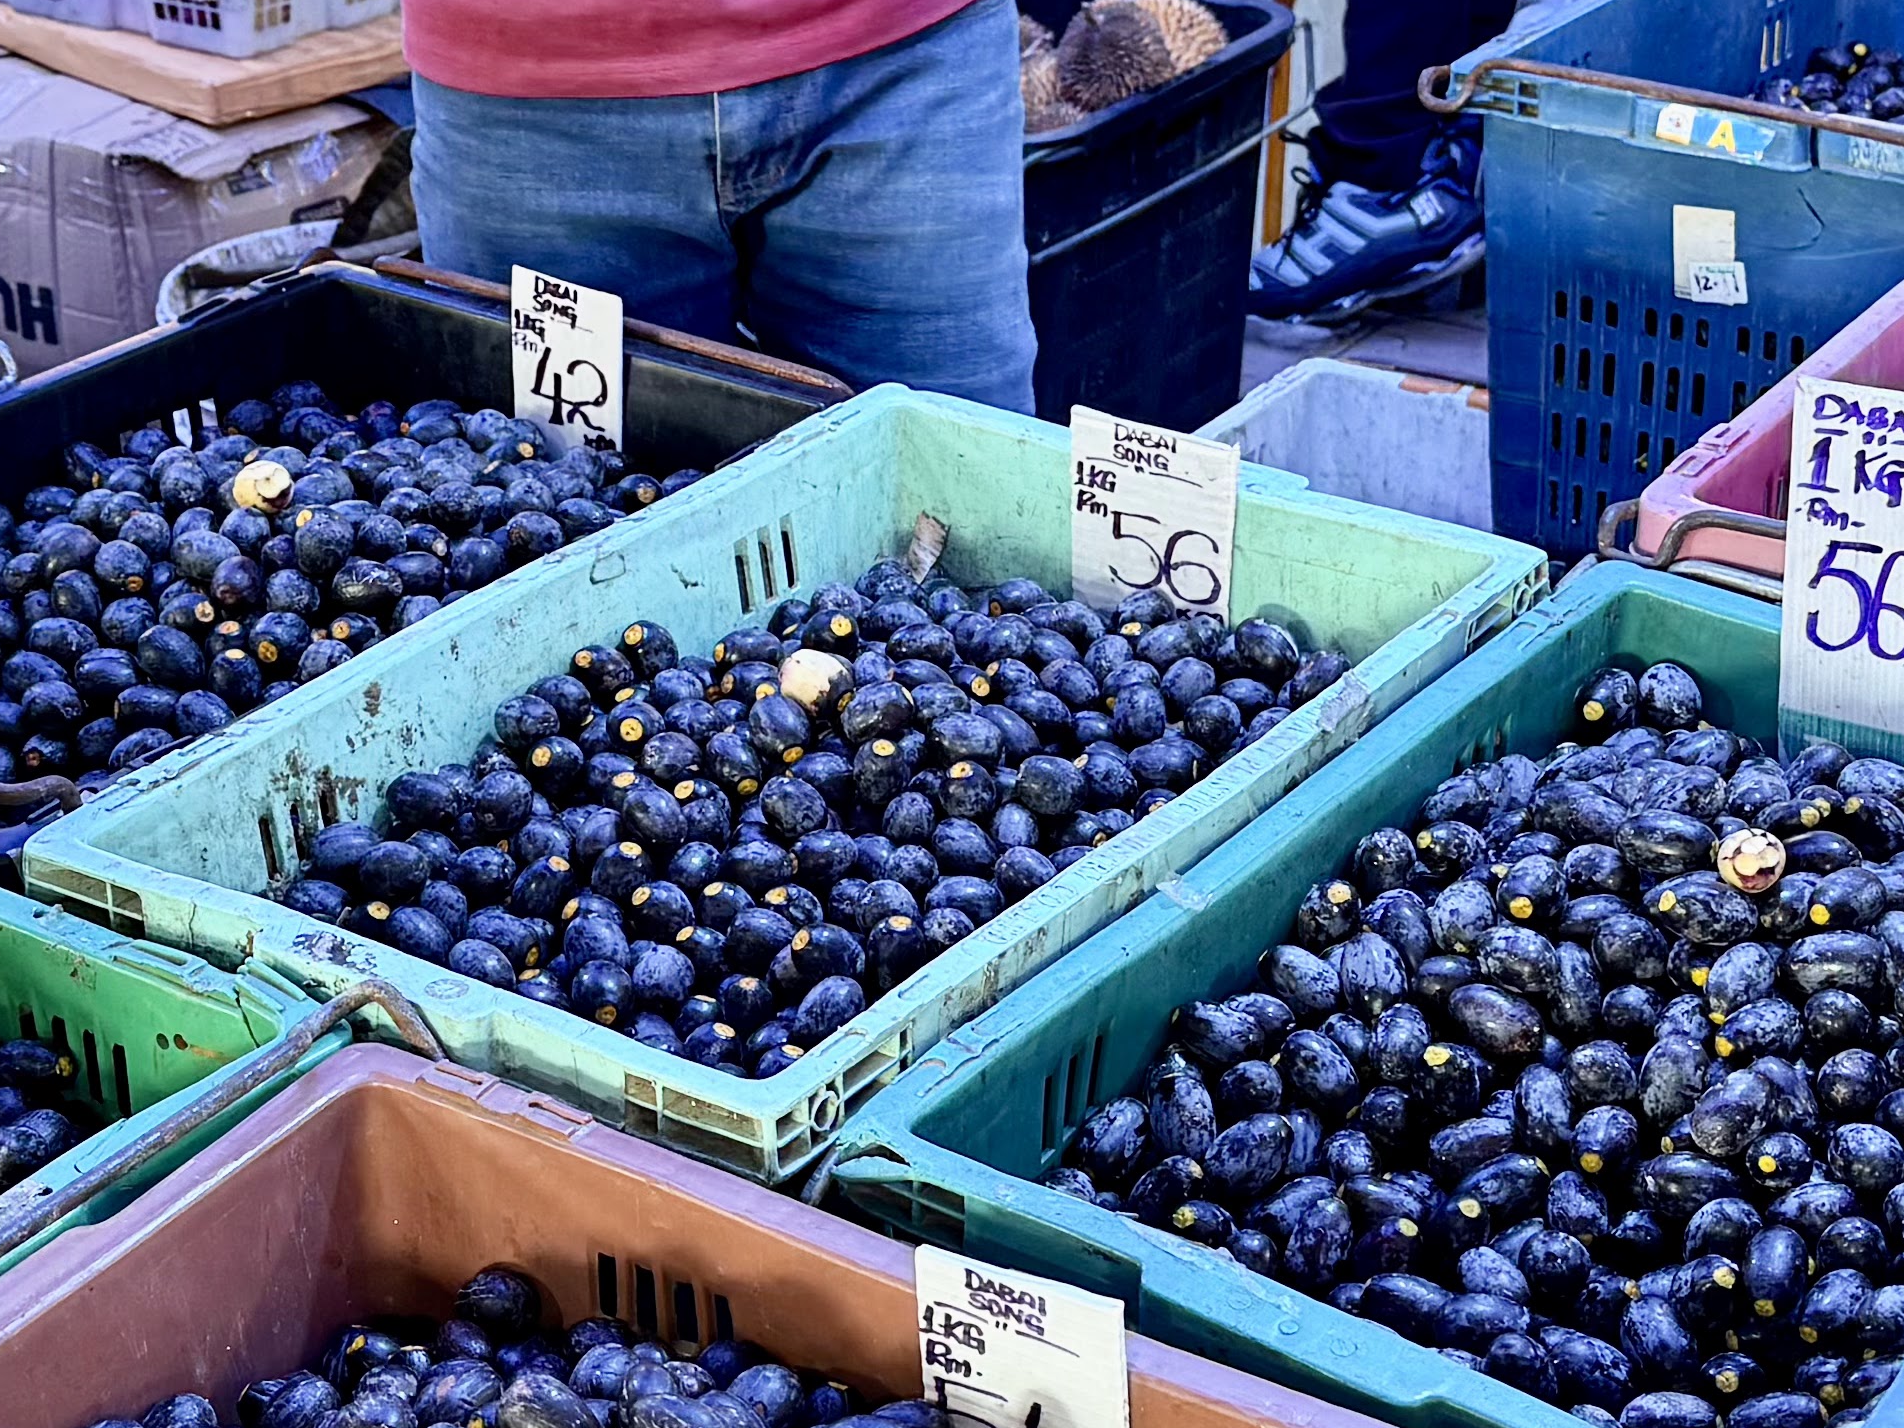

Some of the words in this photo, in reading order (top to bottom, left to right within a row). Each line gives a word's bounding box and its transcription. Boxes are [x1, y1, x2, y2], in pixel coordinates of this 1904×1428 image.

[1707, 119, 1737, 154] A
[530, 347, 609, 432] 42
[1112, 443, 1170, 471] SONG
[1113, 423, 1178, 454] DABAI
[1108, 510, 1223, 605] 56
[963, 1268, 1047, 1317] DABAI
[967, 1292, 1046, 1337] SONG
